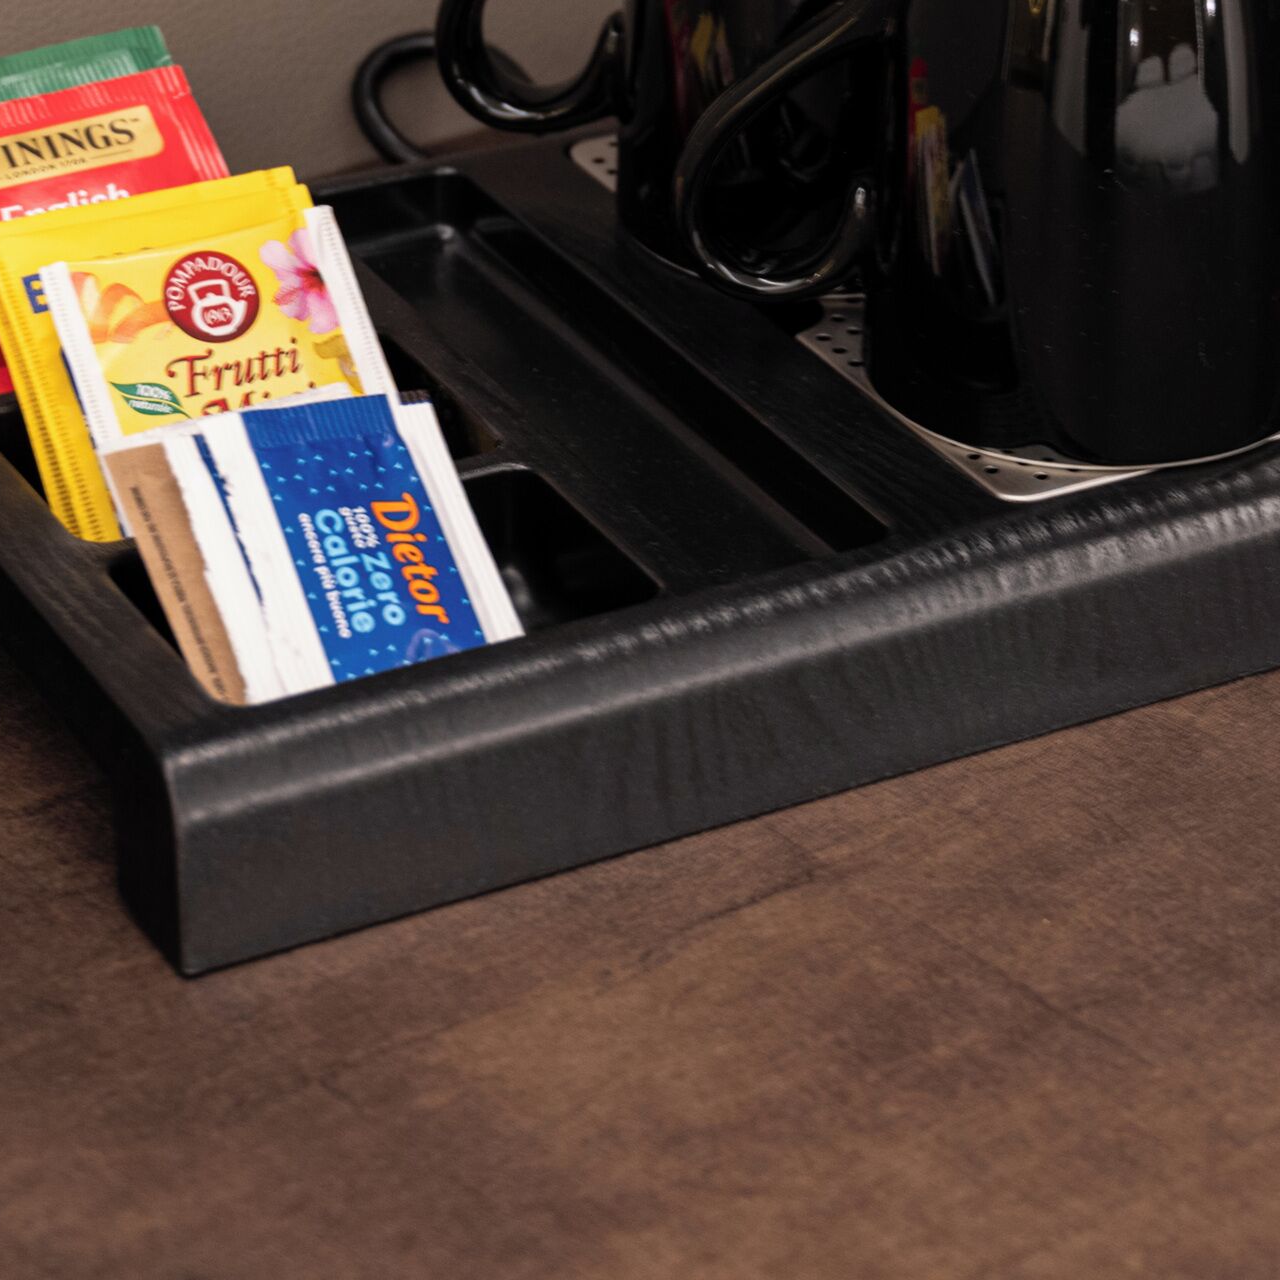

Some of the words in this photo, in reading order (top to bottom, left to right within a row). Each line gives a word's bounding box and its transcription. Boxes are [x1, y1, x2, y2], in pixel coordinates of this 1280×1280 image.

[0, 182, 130, 222] Elih
[166, 256, 256, 312] POMPADOUR
[166, 337, 302, 398] Frutti
[338, 506, 368, 549] gusto
[352, 506, 381, 548] 100%
[314, 508, 377, 633] Calorie
[370, 492, 450, 624] Dietor
[325, 590, 353, 639] buono
[360, 551, 406, 626] Zero
